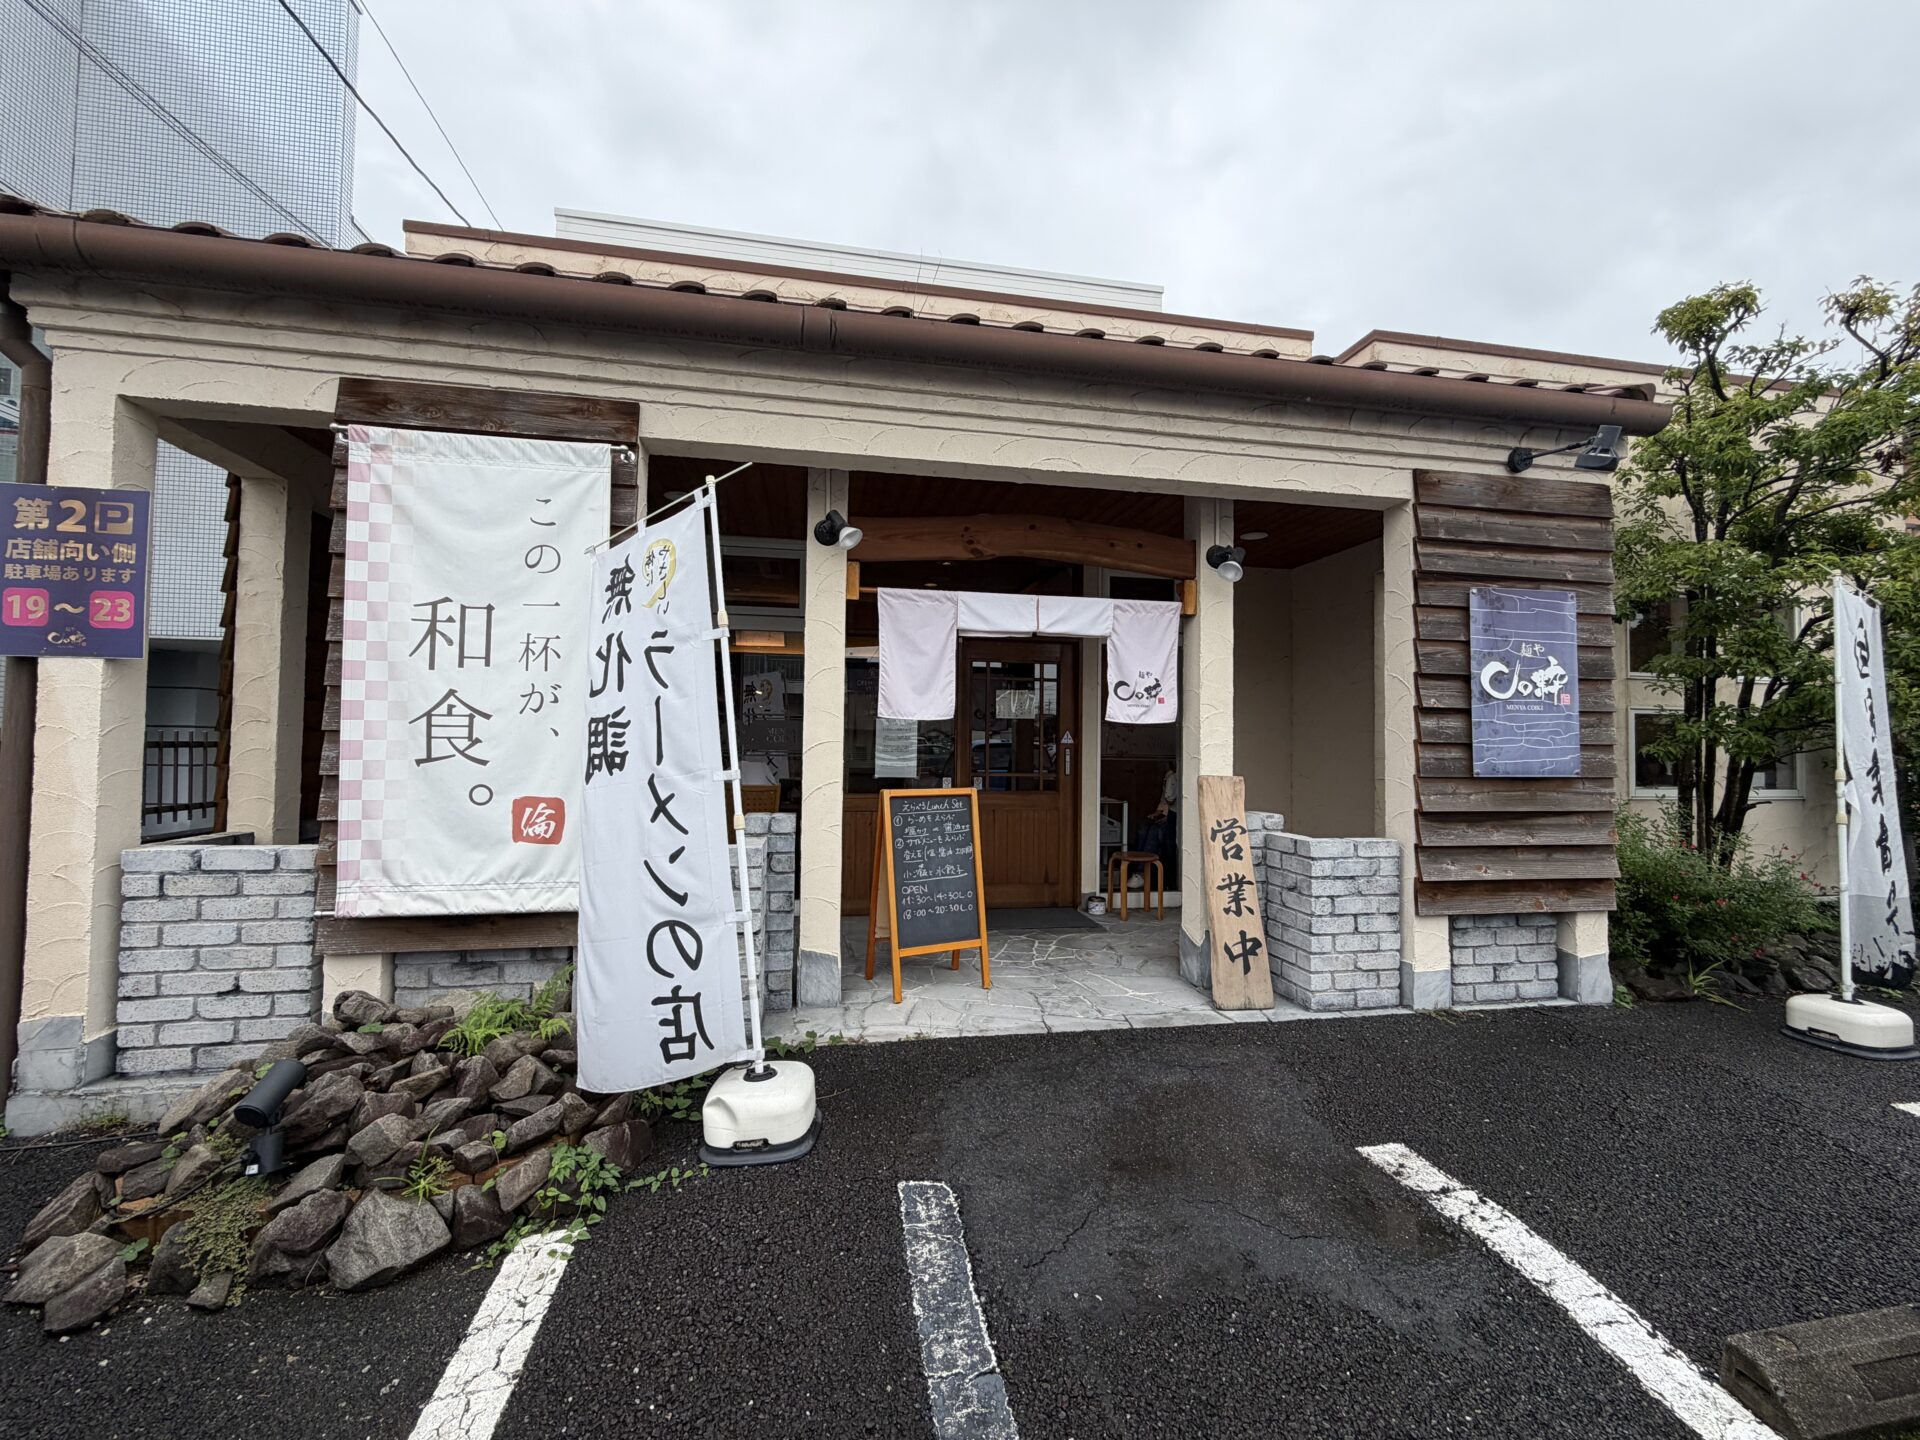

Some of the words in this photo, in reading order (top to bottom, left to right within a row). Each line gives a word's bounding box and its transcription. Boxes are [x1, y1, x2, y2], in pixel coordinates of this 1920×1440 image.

[4, 565, 136, 583] 駐車場あります
[5, 540, 136, 563] 店舗向い側
[518, 498, 562, 737] この一杯が、
[408, 596, 496, 807] 和食。
[901, 884, 928, 895] OPEN
[1211, 818, 1263, 975] 営業中
